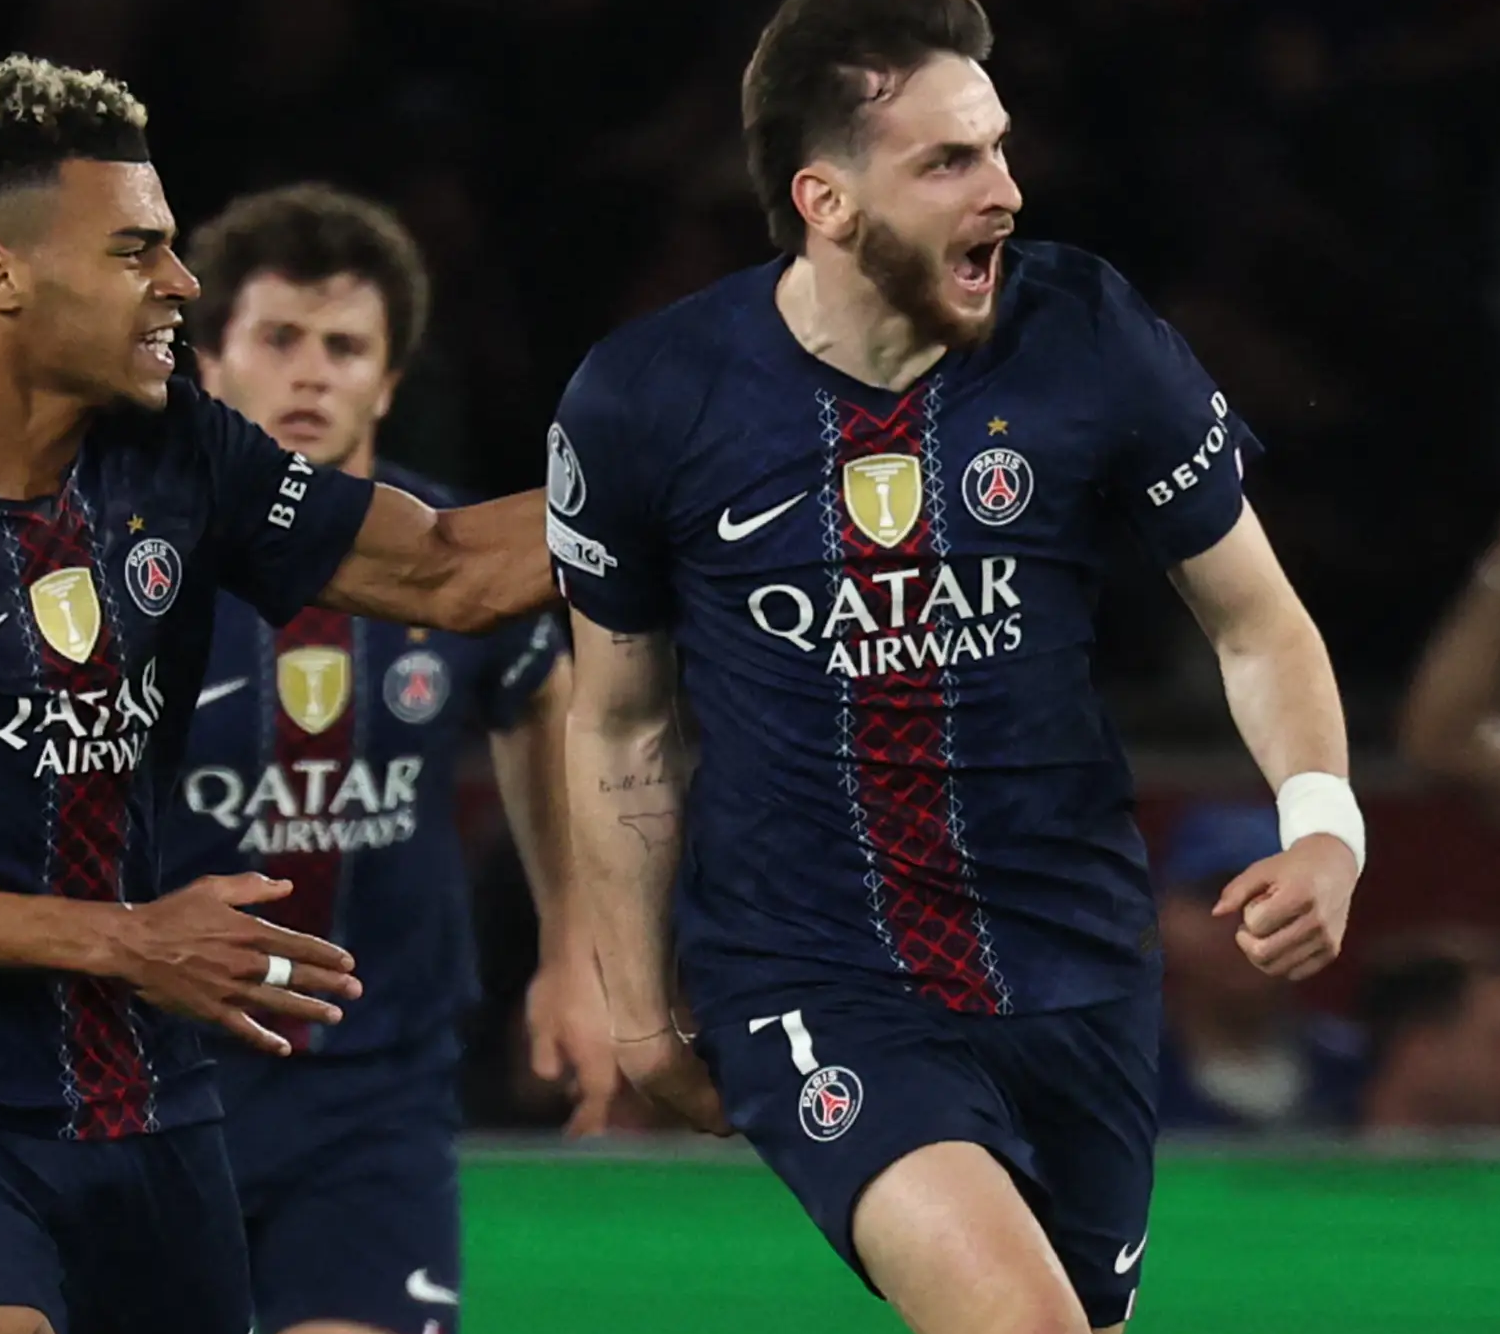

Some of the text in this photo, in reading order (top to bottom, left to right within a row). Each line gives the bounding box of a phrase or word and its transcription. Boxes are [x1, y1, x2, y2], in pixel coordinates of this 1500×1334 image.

[973, 451, 1022, 474] PARIS
[1146, 390, 1228, 507] BEYOD
[267, 451, 314, 529] BEY
[128, 542, 168, 568] PARIS
[746, 555, 1022, 653] QATAR
[826, 612, 1023, 679] AIRWAYS
[184, 755, 425, 830] QATAR
[237, 807, 417, 855] AIRWAYS
[748, 1008, 820, 1076] 7
